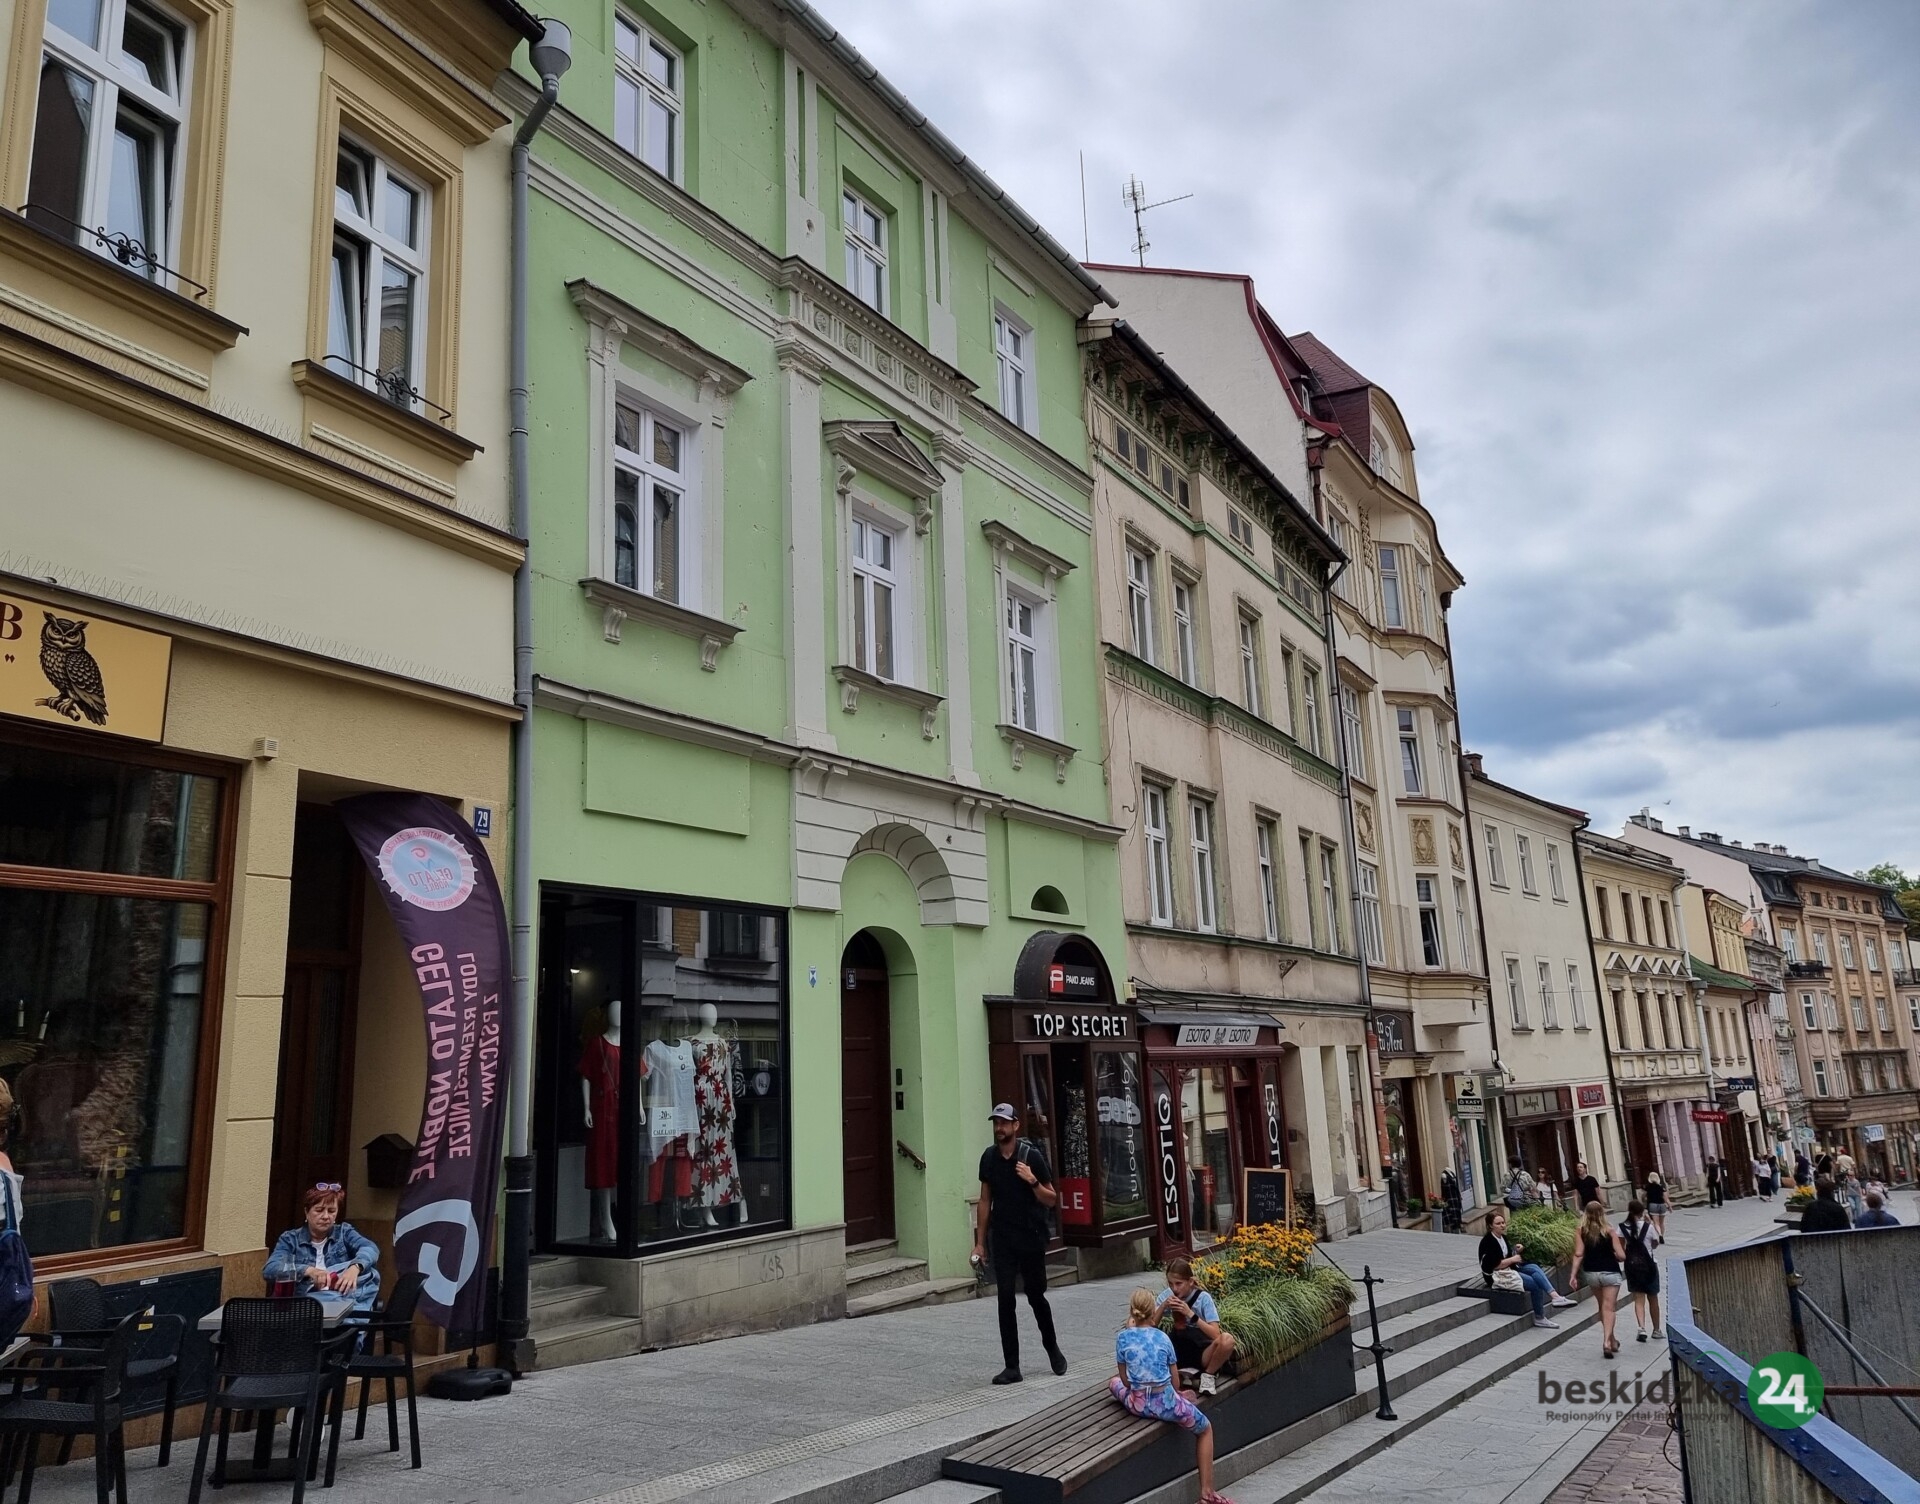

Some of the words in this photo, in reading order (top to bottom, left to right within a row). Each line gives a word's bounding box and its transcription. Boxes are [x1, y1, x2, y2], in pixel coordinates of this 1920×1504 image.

[477, 810, 488, 828] 29
[1065, 974, 1079, 985] PAKO
[1079, 976, 1095, 986] JEANS
[1033, 1013, 1065, 1037] TOP
[1071, 1015, 1128, 1037] SECRET
[1185, 1028, 1211, 1044] ESOTIQ
[1228, 1028, 1252, 1044] ESOTIQ
[1694, 1112, 1719, 1121] Triumph
[1121, 1068, 1140, 1201] greenpoint
[1264, 1083, 1282, 1170] ESOTI
[1158, 1092, 1180, 1225] ESOTIQ
[1202, 1174, 1214, 1185] SALE
[1060, 1191, 1084, 1210] LE
